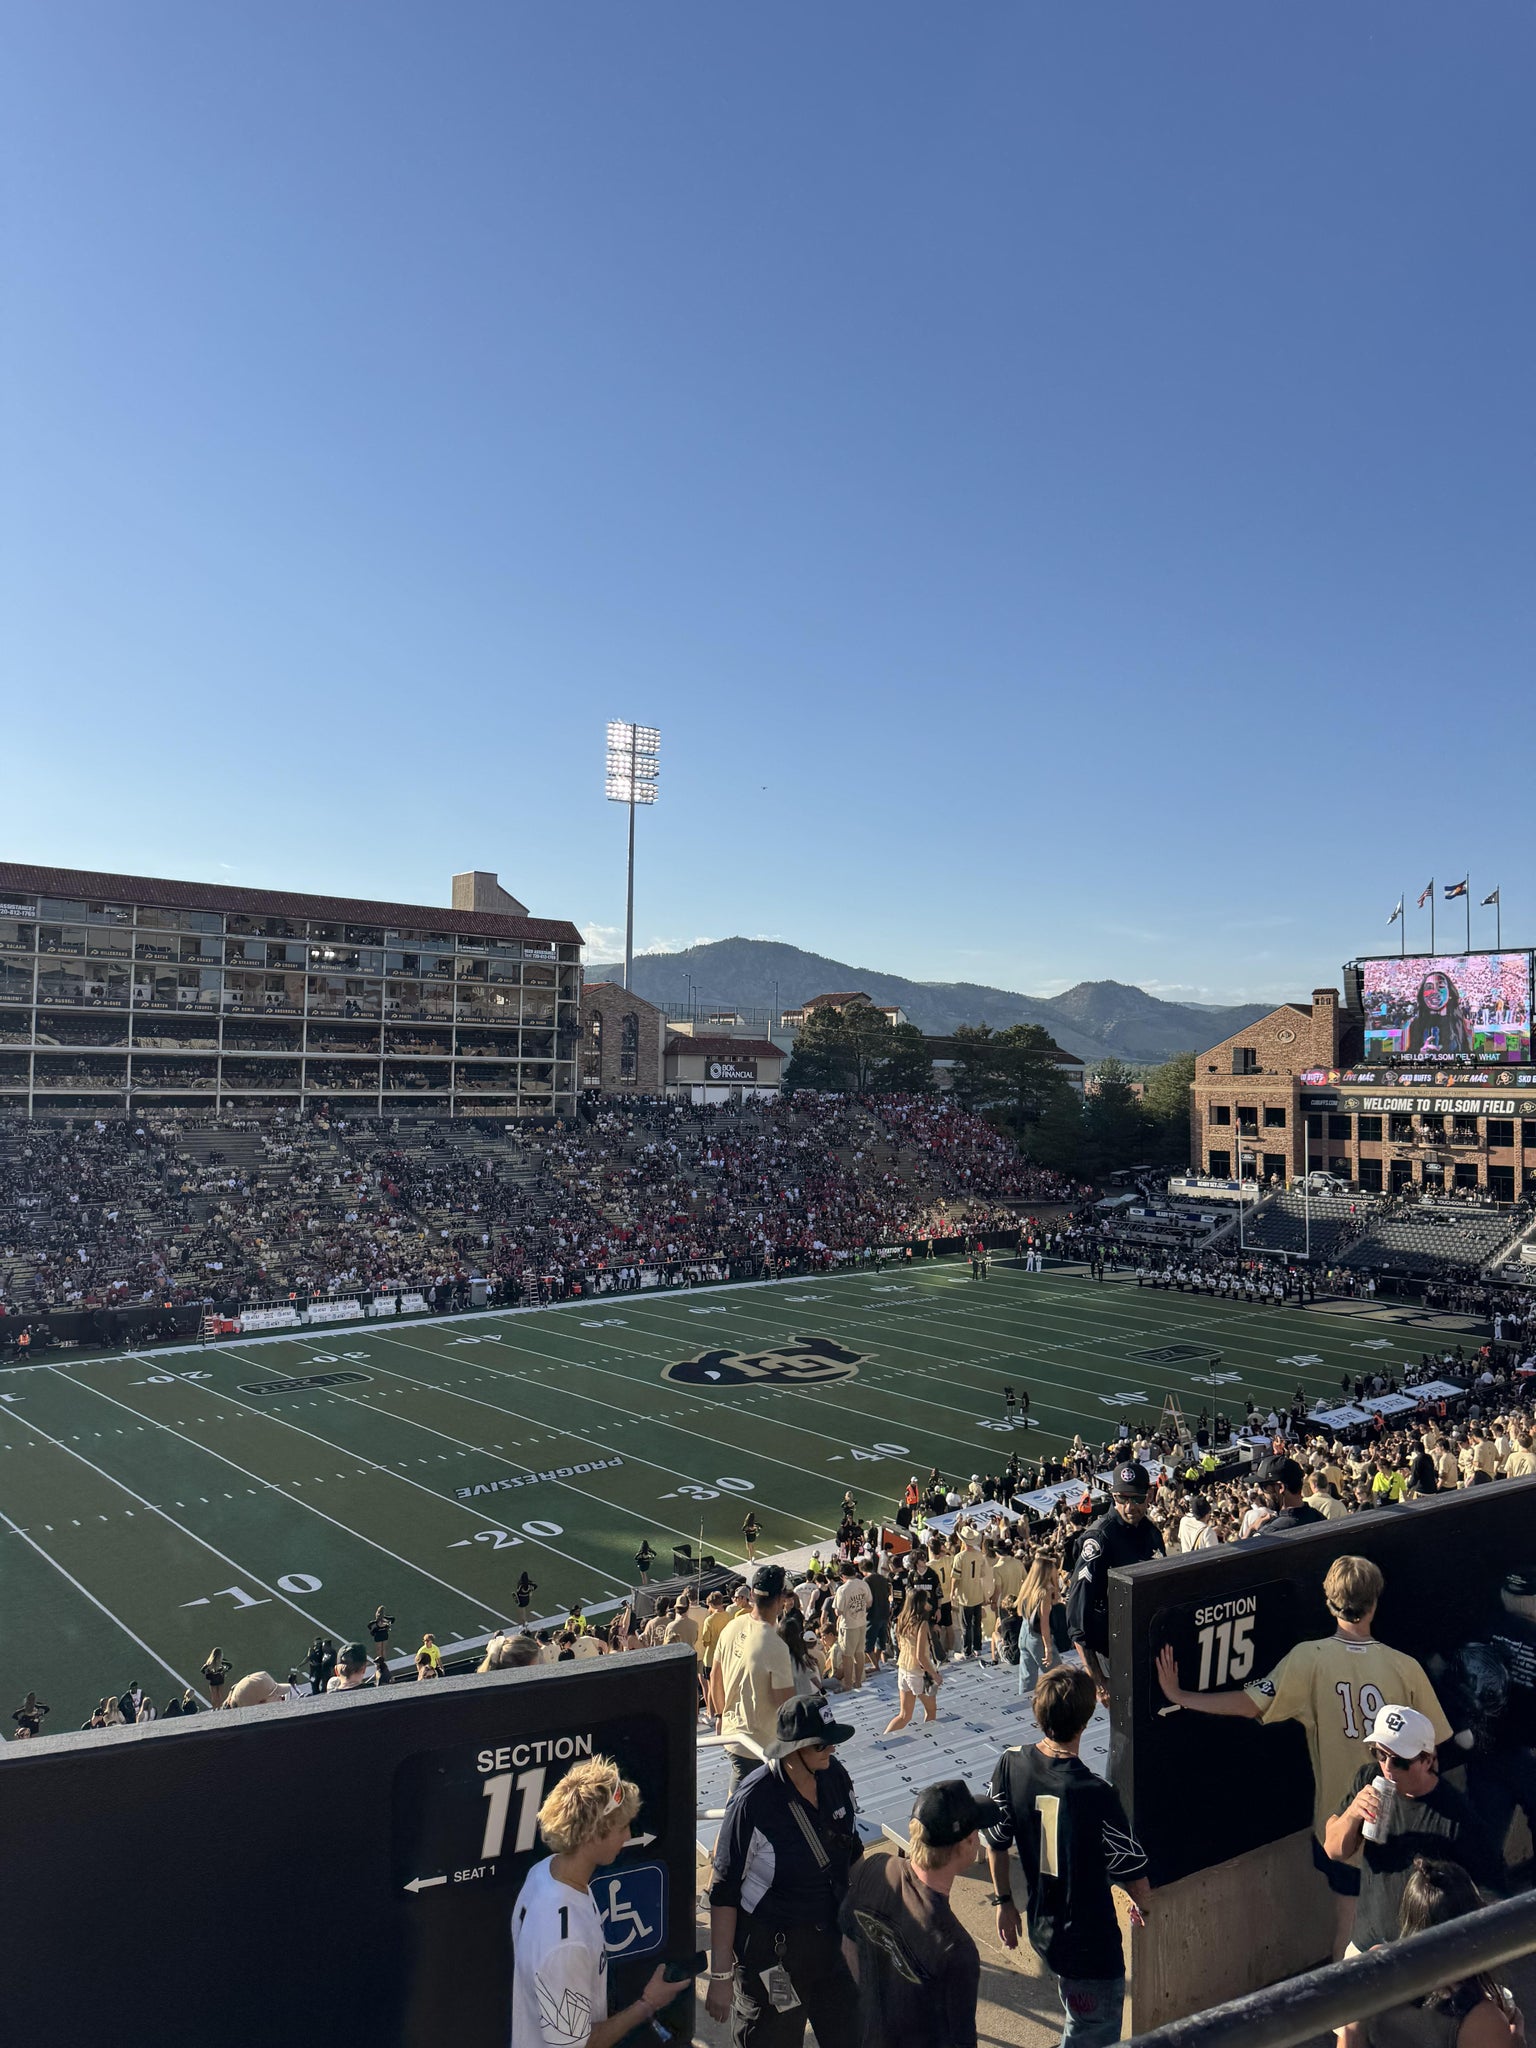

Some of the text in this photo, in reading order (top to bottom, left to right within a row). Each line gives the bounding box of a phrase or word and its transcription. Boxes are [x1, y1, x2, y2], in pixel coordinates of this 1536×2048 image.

[1479, 1053, 1500, 1061] WHAT
[1454, 1072, 1488, 1083] LIVE MÁS
[1363, 1097, 1515, 1114] WELCOME TO FOLSOM FIELD
[1437, 1199, 1467, 1207] TOUCHDOWN
[455, 1333, 502, 1344] 40
[312, 1351, 371, 1363] 30
[146, 1370, 213, 1384] 20
[1098, 1392, 1149, 1407] 40
[850, 1442, 910, 1462] 40
[455, 1456, 624, 1499] PROGRESSIVE
[676, 1476, 755, 1500] 30
[474, 1520, 564, 1550] 20
[940, 1566, 946, 1584] 1
[971, 1560, 976, 1579] 1
[213, 1573, 323, 1610] 10
[1194, 1595, 1257, 1626] SECTION
[1198, 1614, 1255, 1692] 115
[1335, 1681, 1387, 1739] 19
[476, 1733, 592, 1773] SECTION
[1035, 1795, 1060, 1877] 1
[453, 1865, 496, 1883] SEAT 1
[558, 1906, 568, 1939] 1
